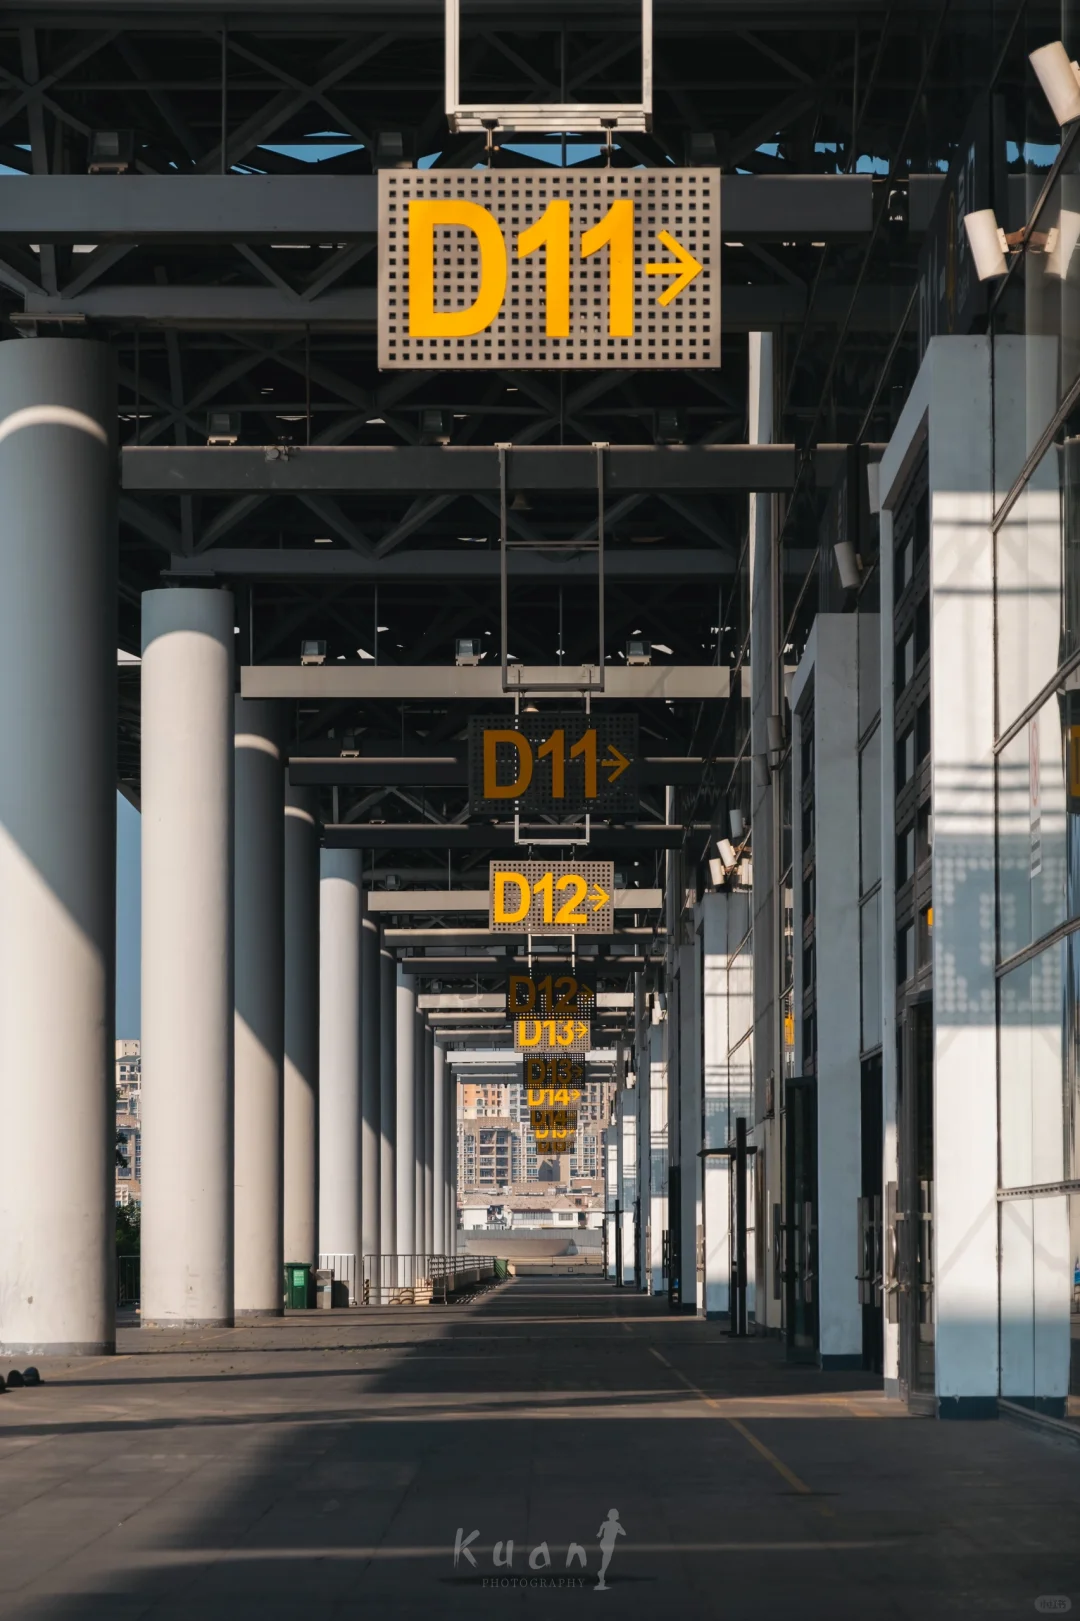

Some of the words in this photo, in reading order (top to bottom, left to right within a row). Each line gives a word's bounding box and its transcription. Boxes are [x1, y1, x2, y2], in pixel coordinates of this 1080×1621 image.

[407, 199, 636, 338] D11
[483, 729, 597, 798] D11
[493, 872, 588, 924] D12
[509, 975, 578, 1013] D12
[518, 1020, 574, 1046] D13
[527, 1057, 573, 1085] D13
[528, 1088, 571, 1107] D14
